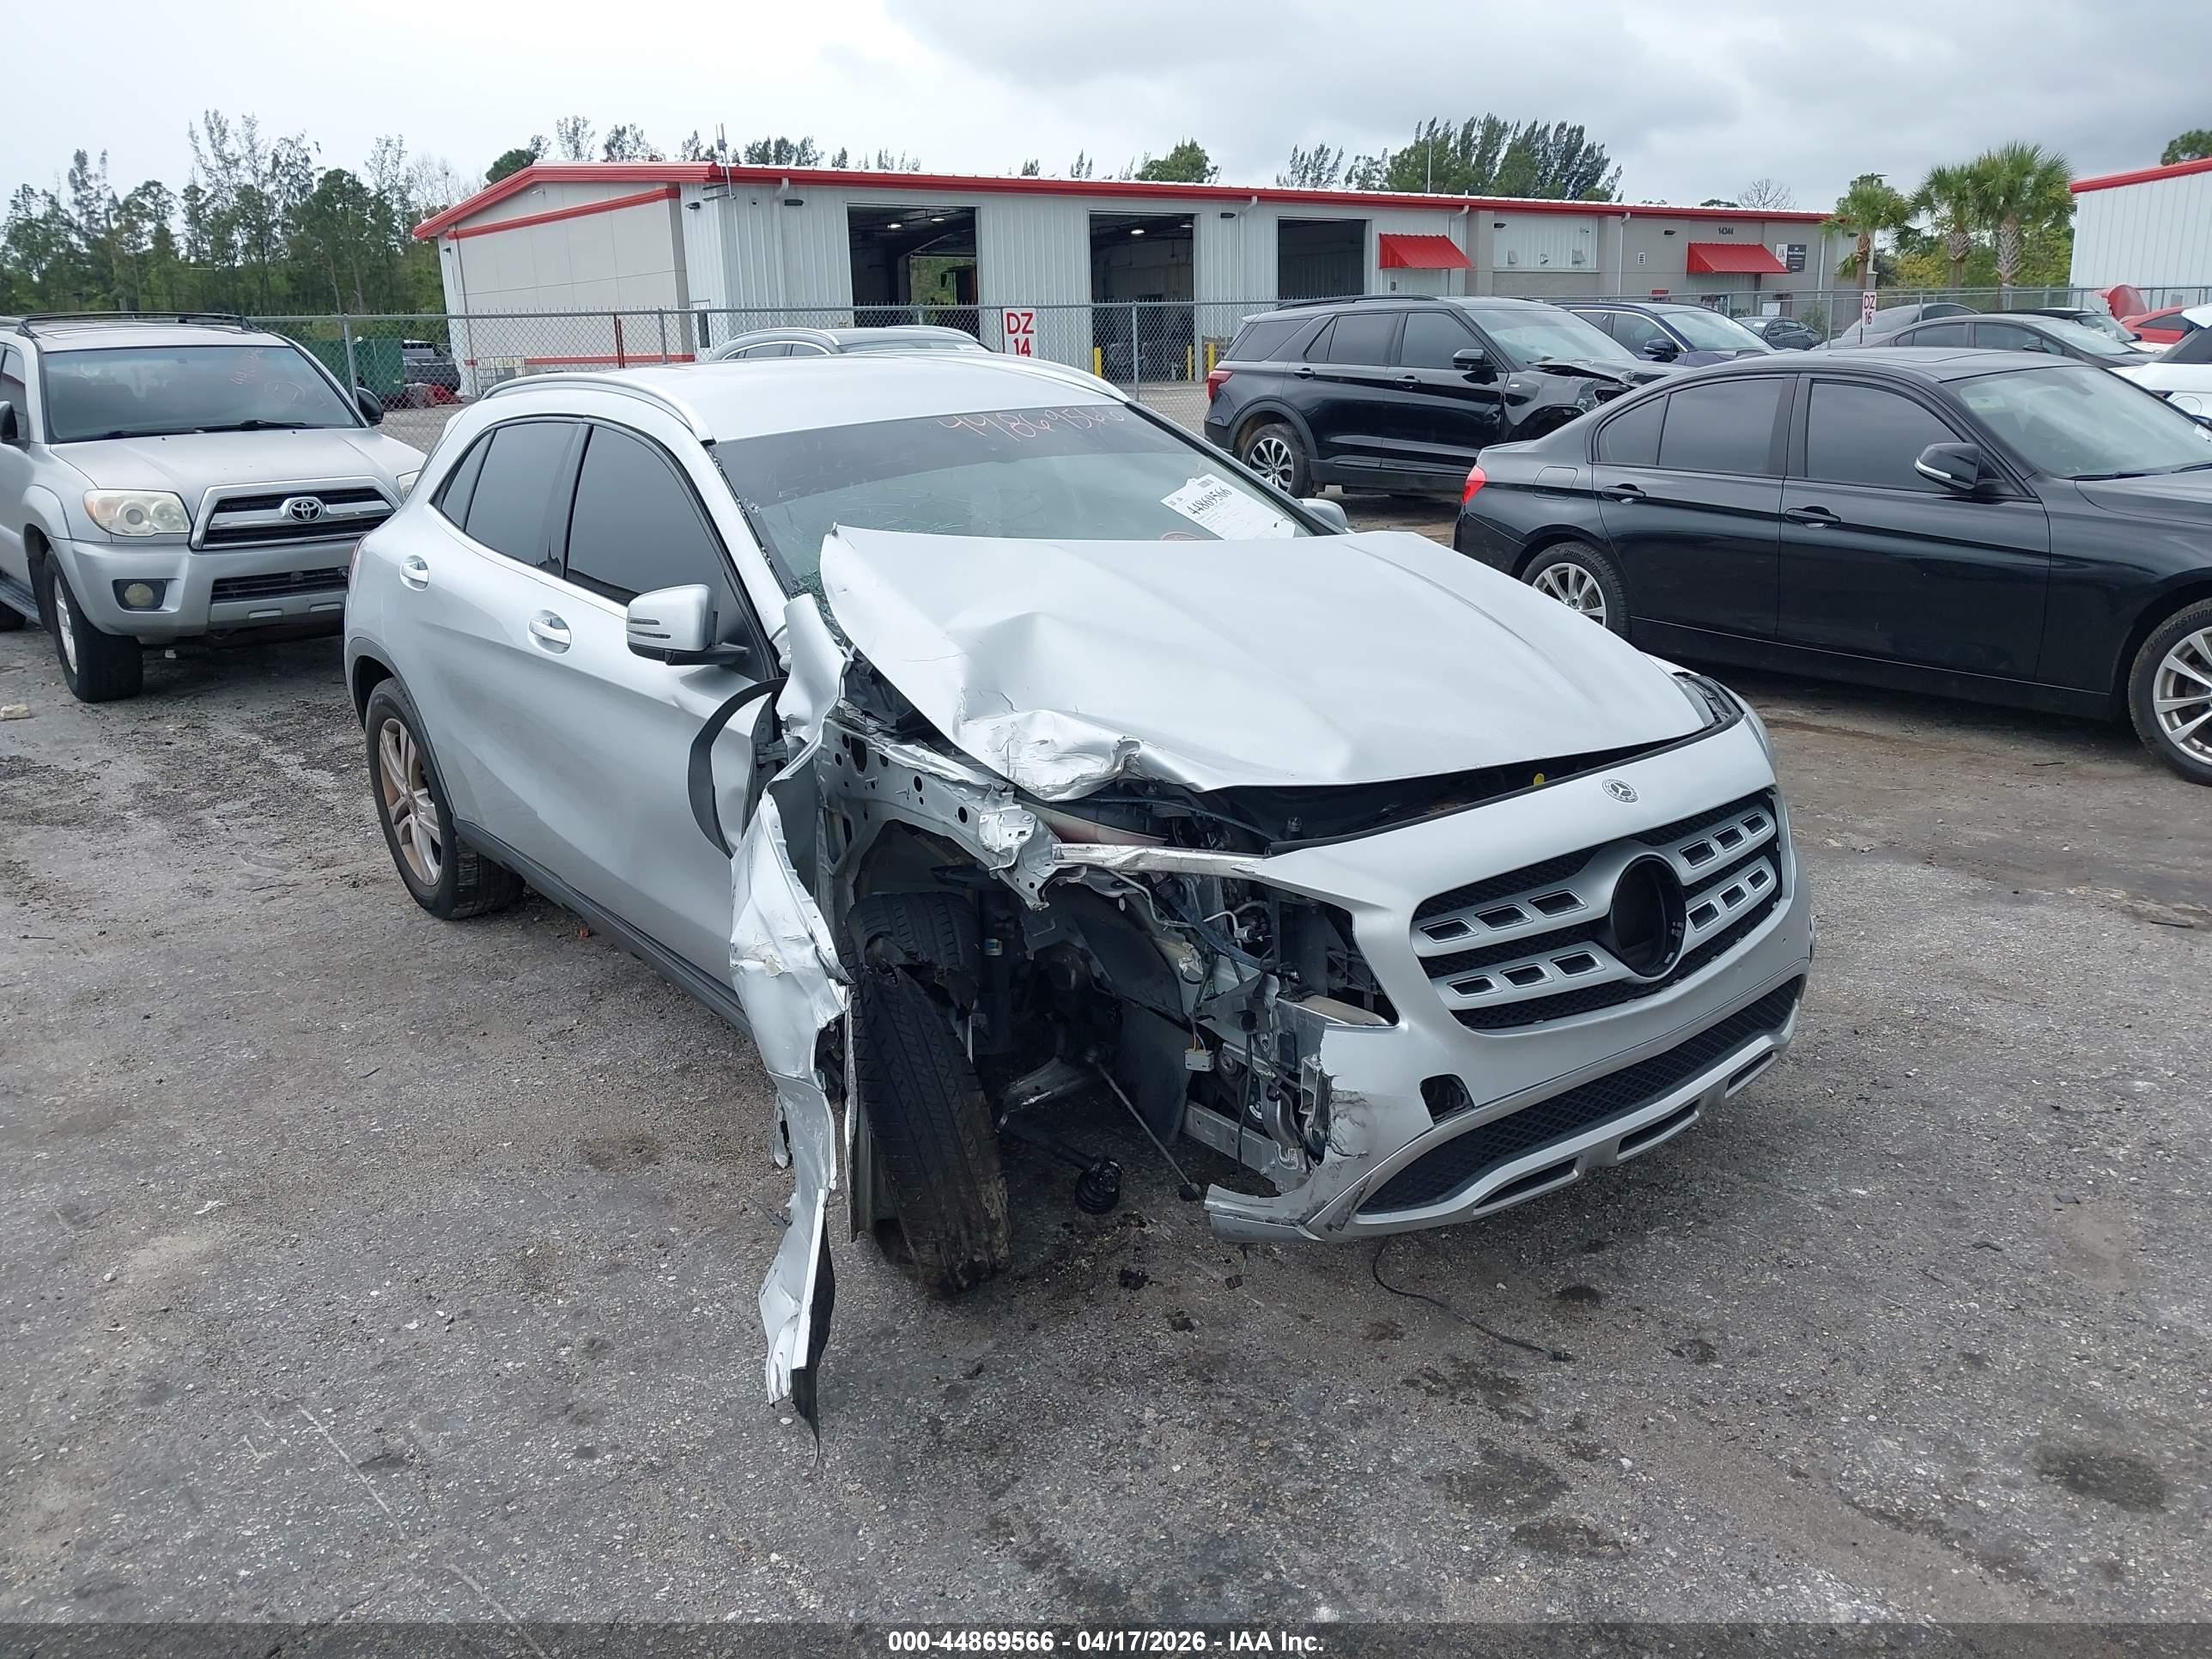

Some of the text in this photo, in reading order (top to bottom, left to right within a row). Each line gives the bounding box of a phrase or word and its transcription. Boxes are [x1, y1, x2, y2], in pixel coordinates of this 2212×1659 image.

[1864, 295, 1875, 309] DZ
[1006, 312, 1035, 335] DZ
[1865, 311, 1872, 325] 16
[1013, 337, 1031, 358] 14
[1187, 486, 1233, 515] 44869566
